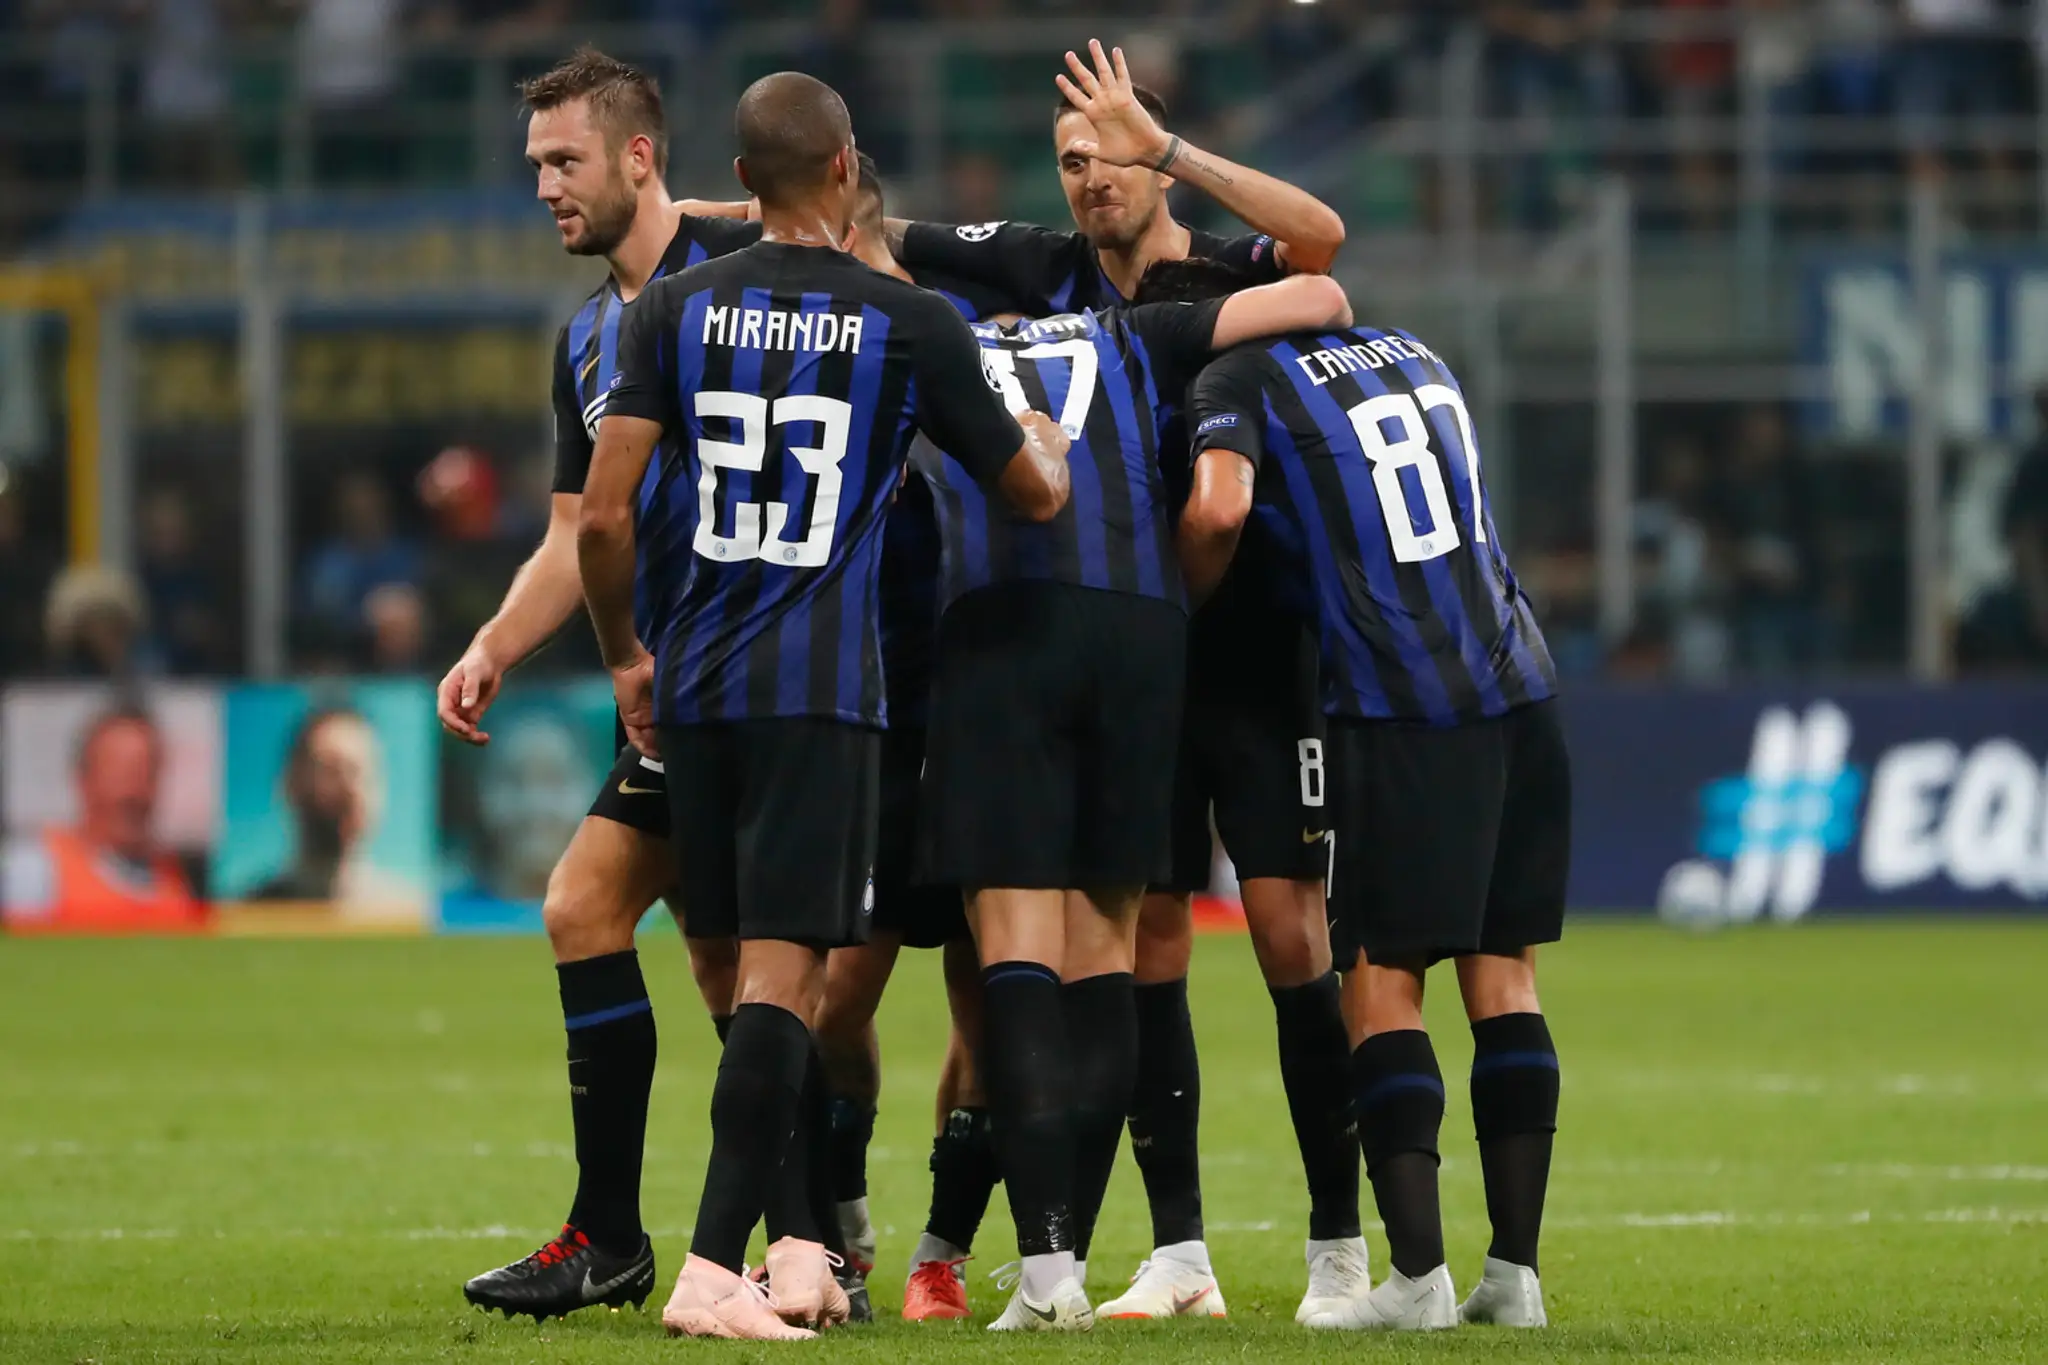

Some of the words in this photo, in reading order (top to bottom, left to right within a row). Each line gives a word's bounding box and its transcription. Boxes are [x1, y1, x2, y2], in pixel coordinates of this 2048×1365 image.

[702, 305, 864, 355] MIRANDA
[692, 391, 852, 567] 23
[1346, 384, 1487, 563] 87
[1298, 737, 1325, 807] 8
